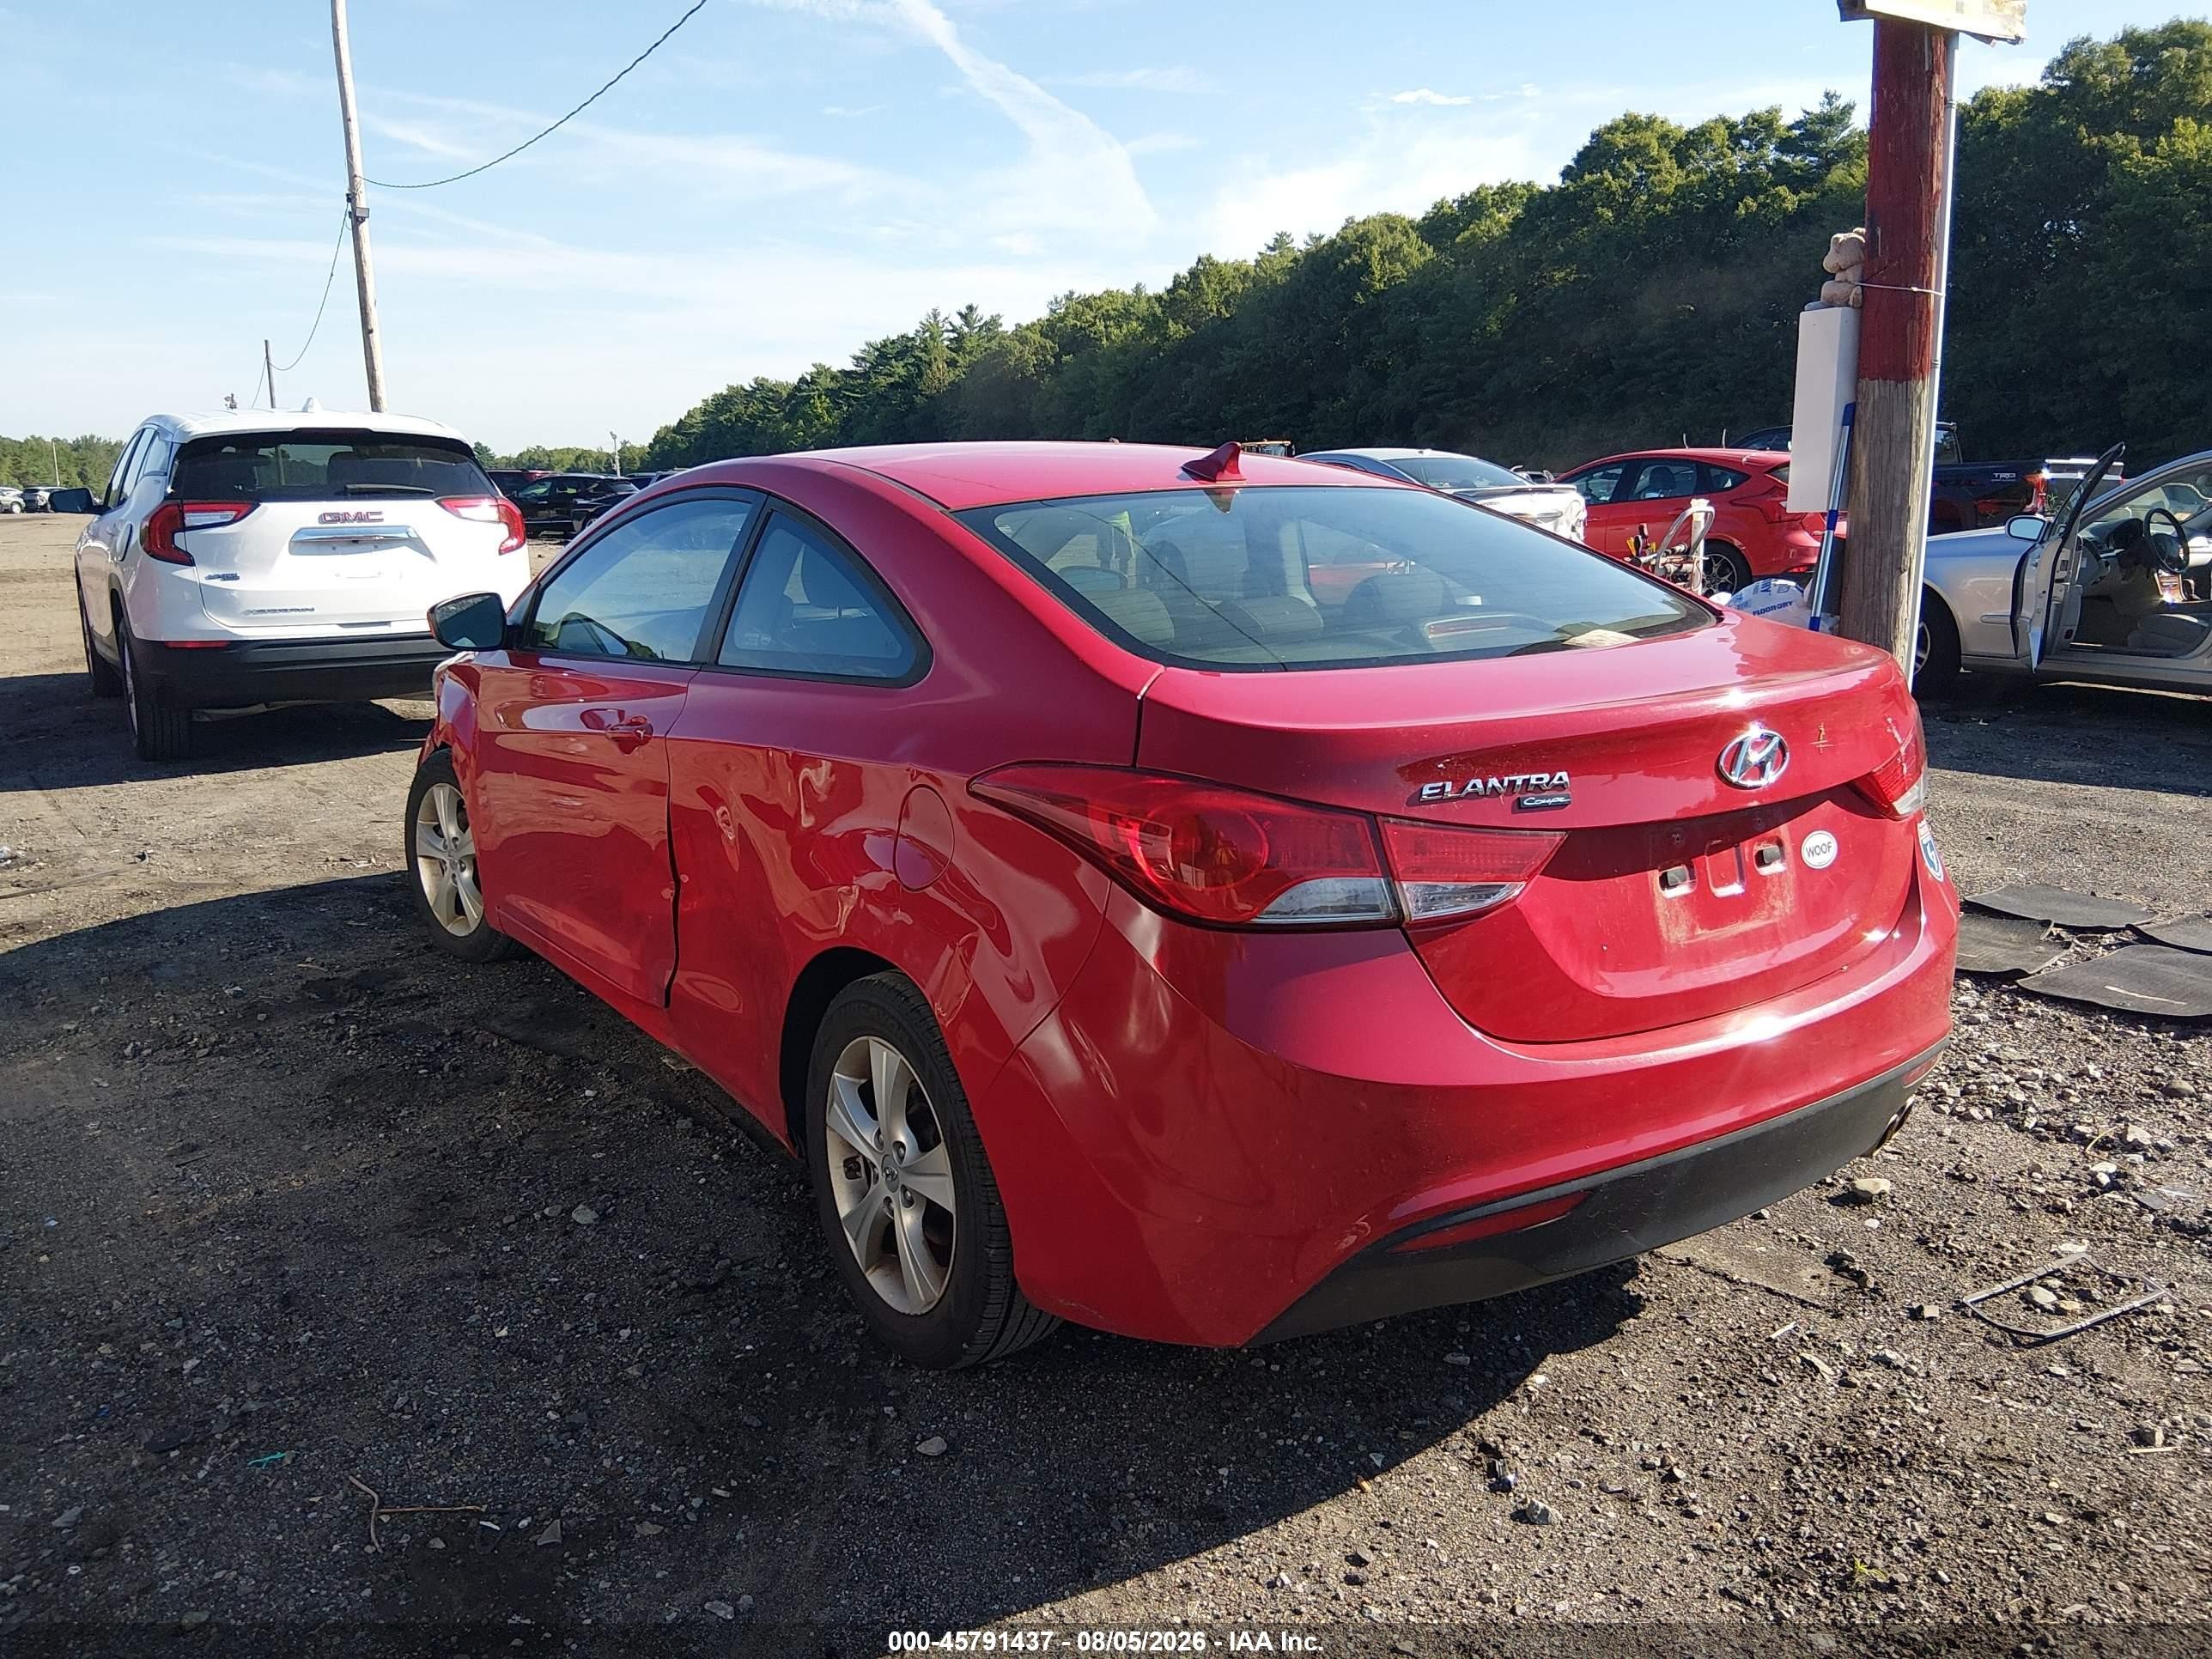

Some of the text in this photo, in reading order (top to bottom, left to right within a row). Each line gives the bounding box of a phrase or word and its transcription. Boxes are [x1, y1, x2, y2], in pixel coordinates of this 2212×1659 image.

[318, 511, 385, 524] GMC
[1419, 770, 1571, 803] ELANTRA
[1522, 795, 1572, 806] Coupe
[1805, 841, 1832, 858] WOOF
